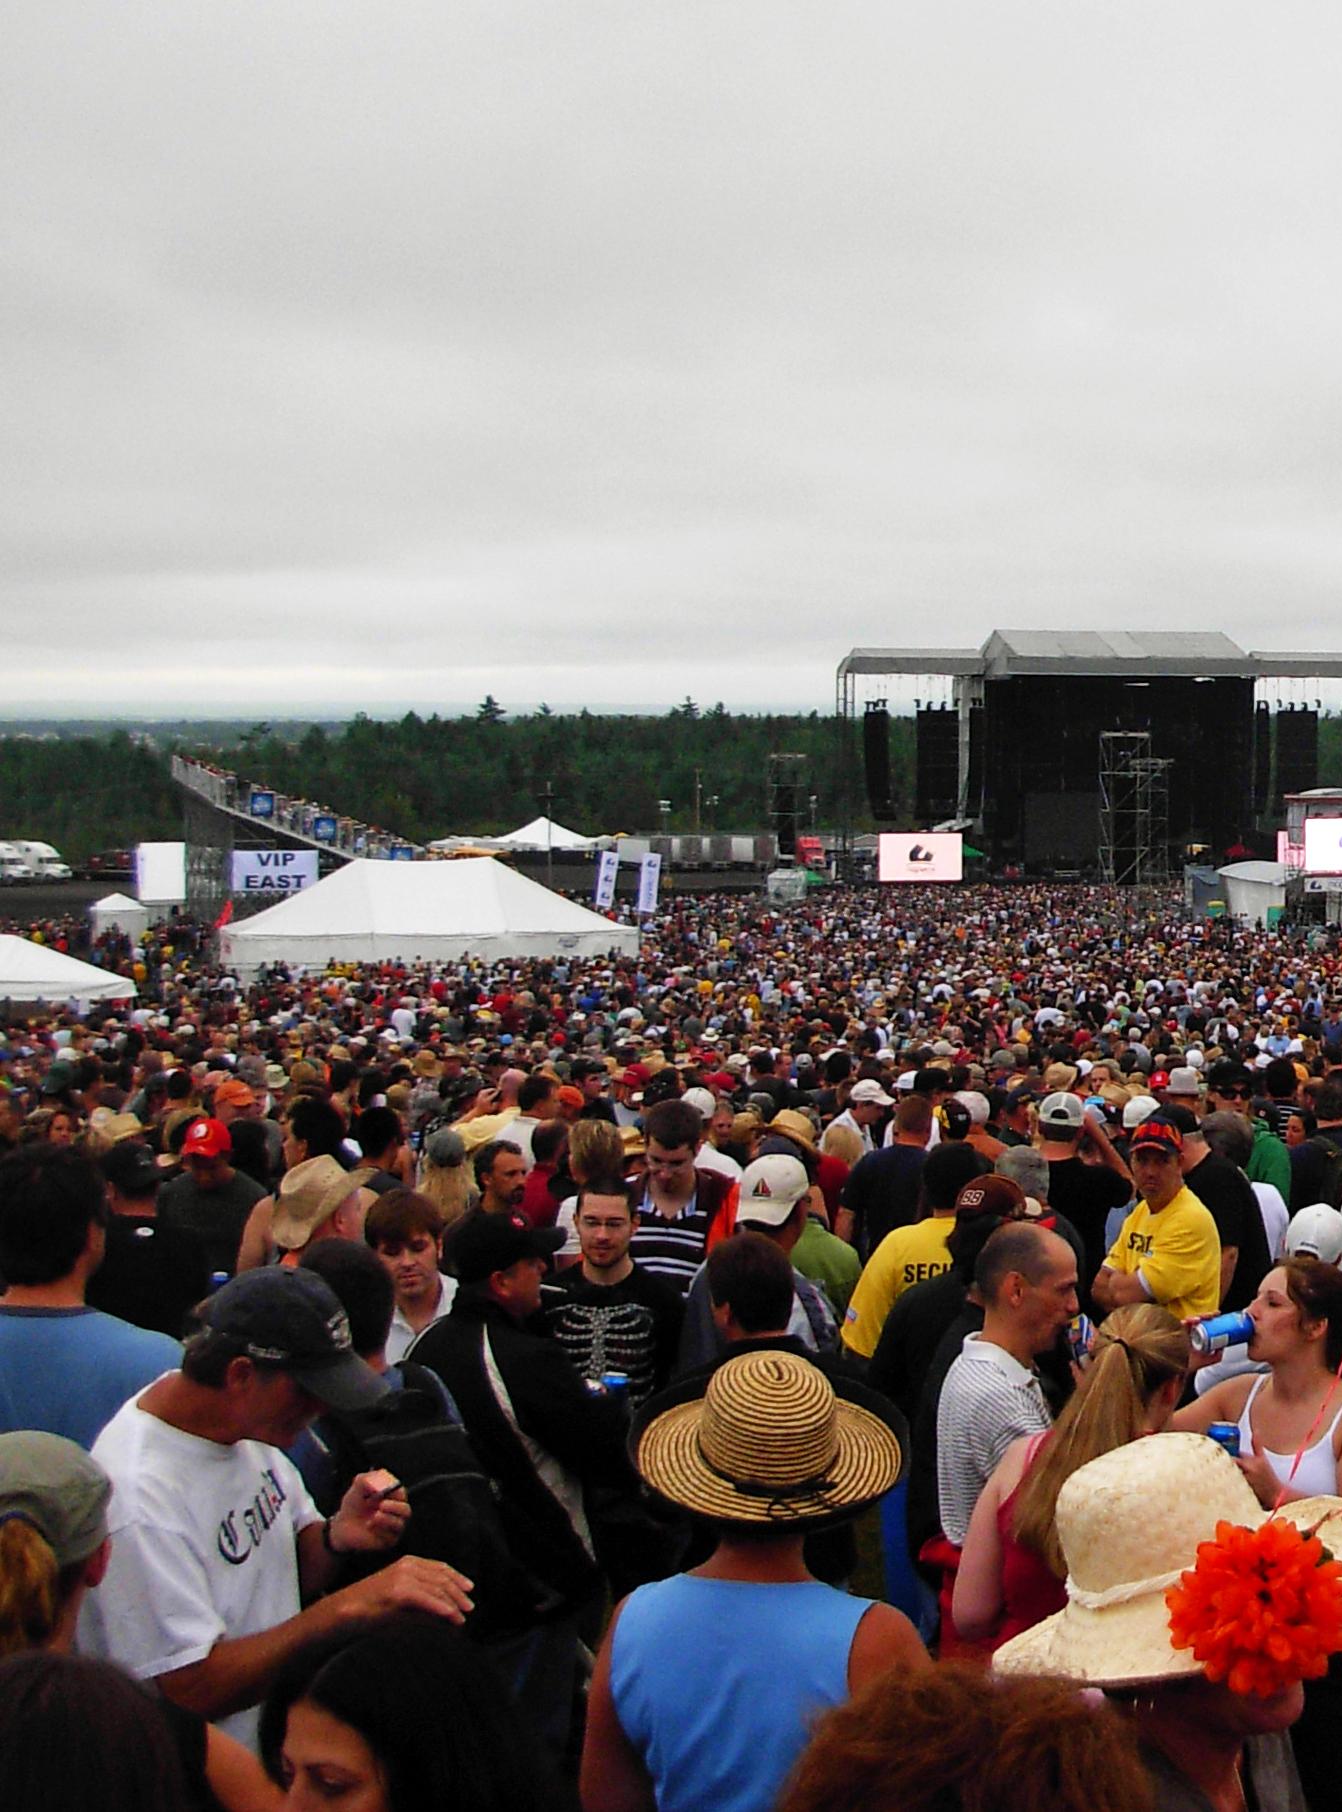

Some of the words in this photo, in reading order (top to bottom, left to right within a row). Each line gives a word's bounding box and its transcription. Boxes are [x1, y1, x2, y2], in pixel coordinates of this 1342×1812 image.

[257, 853, 296, 867] VIP
[244, 874, 307, 889] EAST
[960, 1189, 985, 1205] 88
